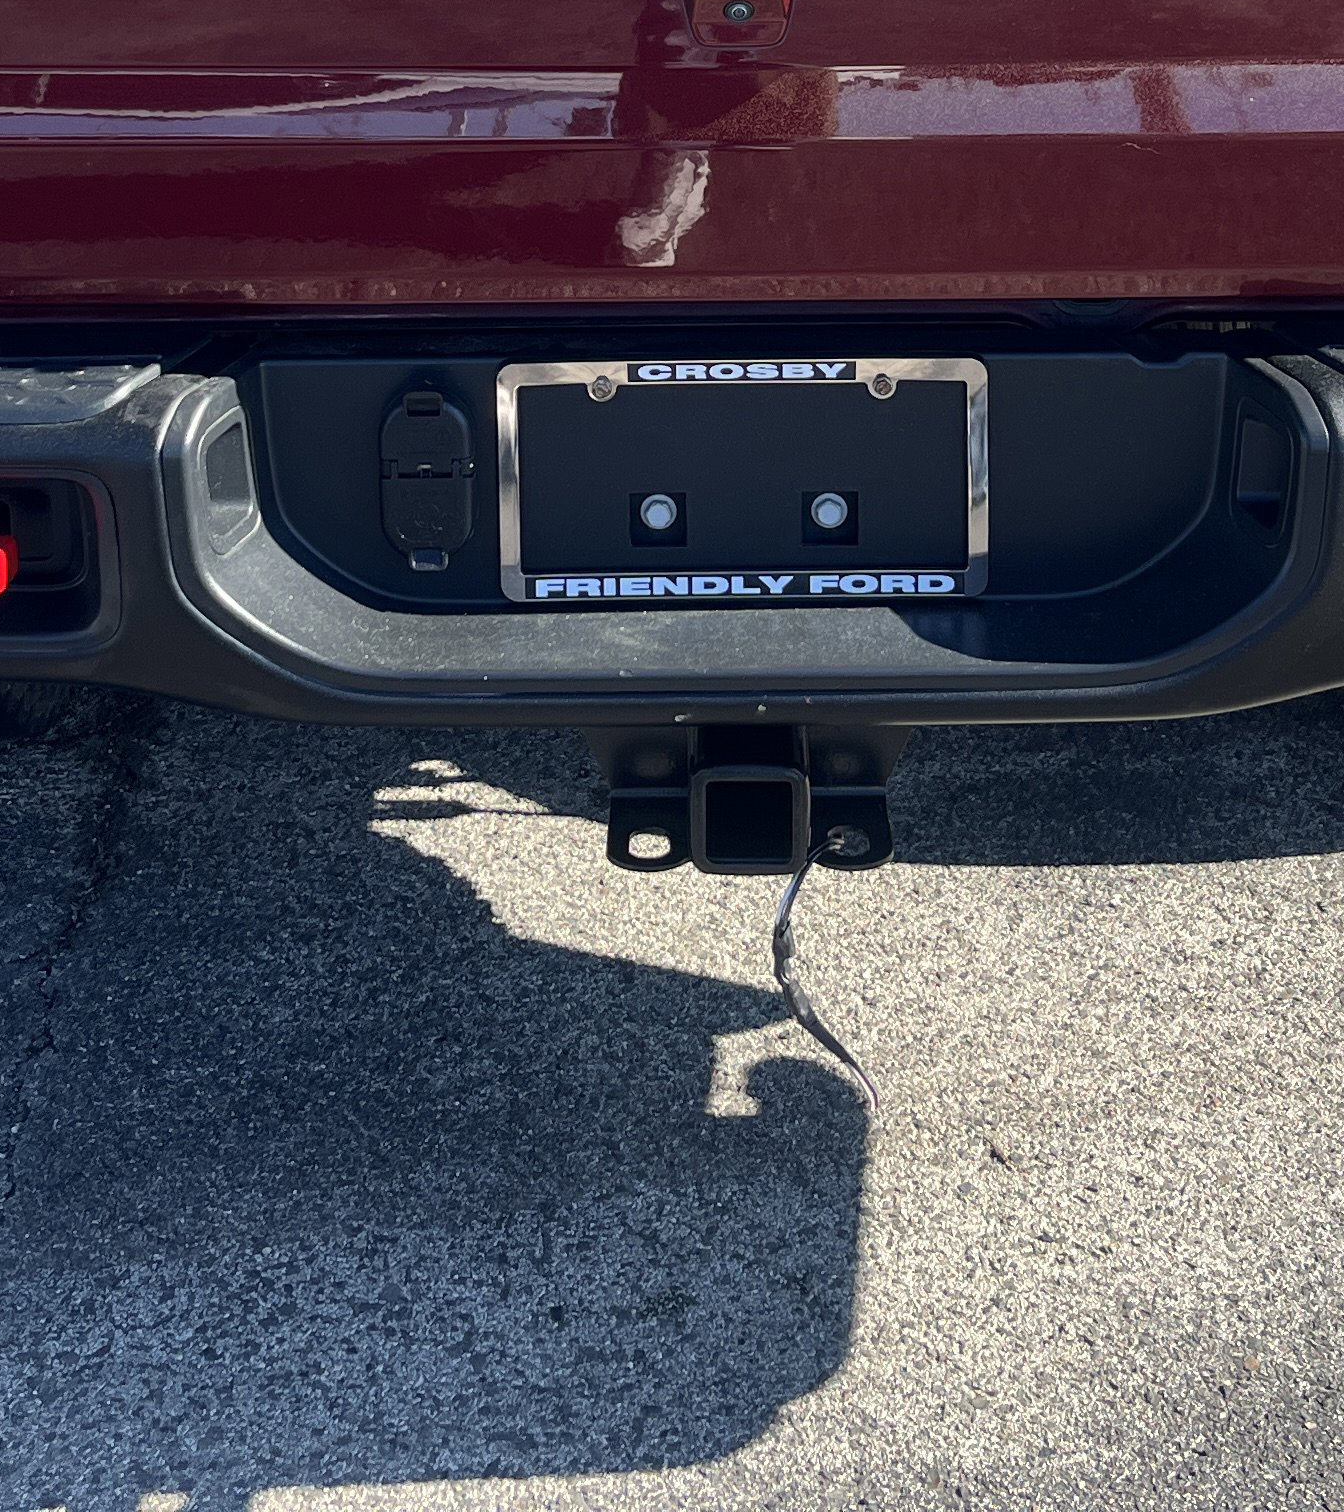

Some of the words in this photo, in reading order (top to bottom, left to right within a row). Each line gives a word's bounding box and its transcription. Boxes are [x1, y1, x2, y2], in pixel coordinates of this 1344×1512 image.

[637, 362, 847, 381] CROSBY
[534, 575, 794, 598] FRIENDLY
[809, 574, 957, 594] FORD
